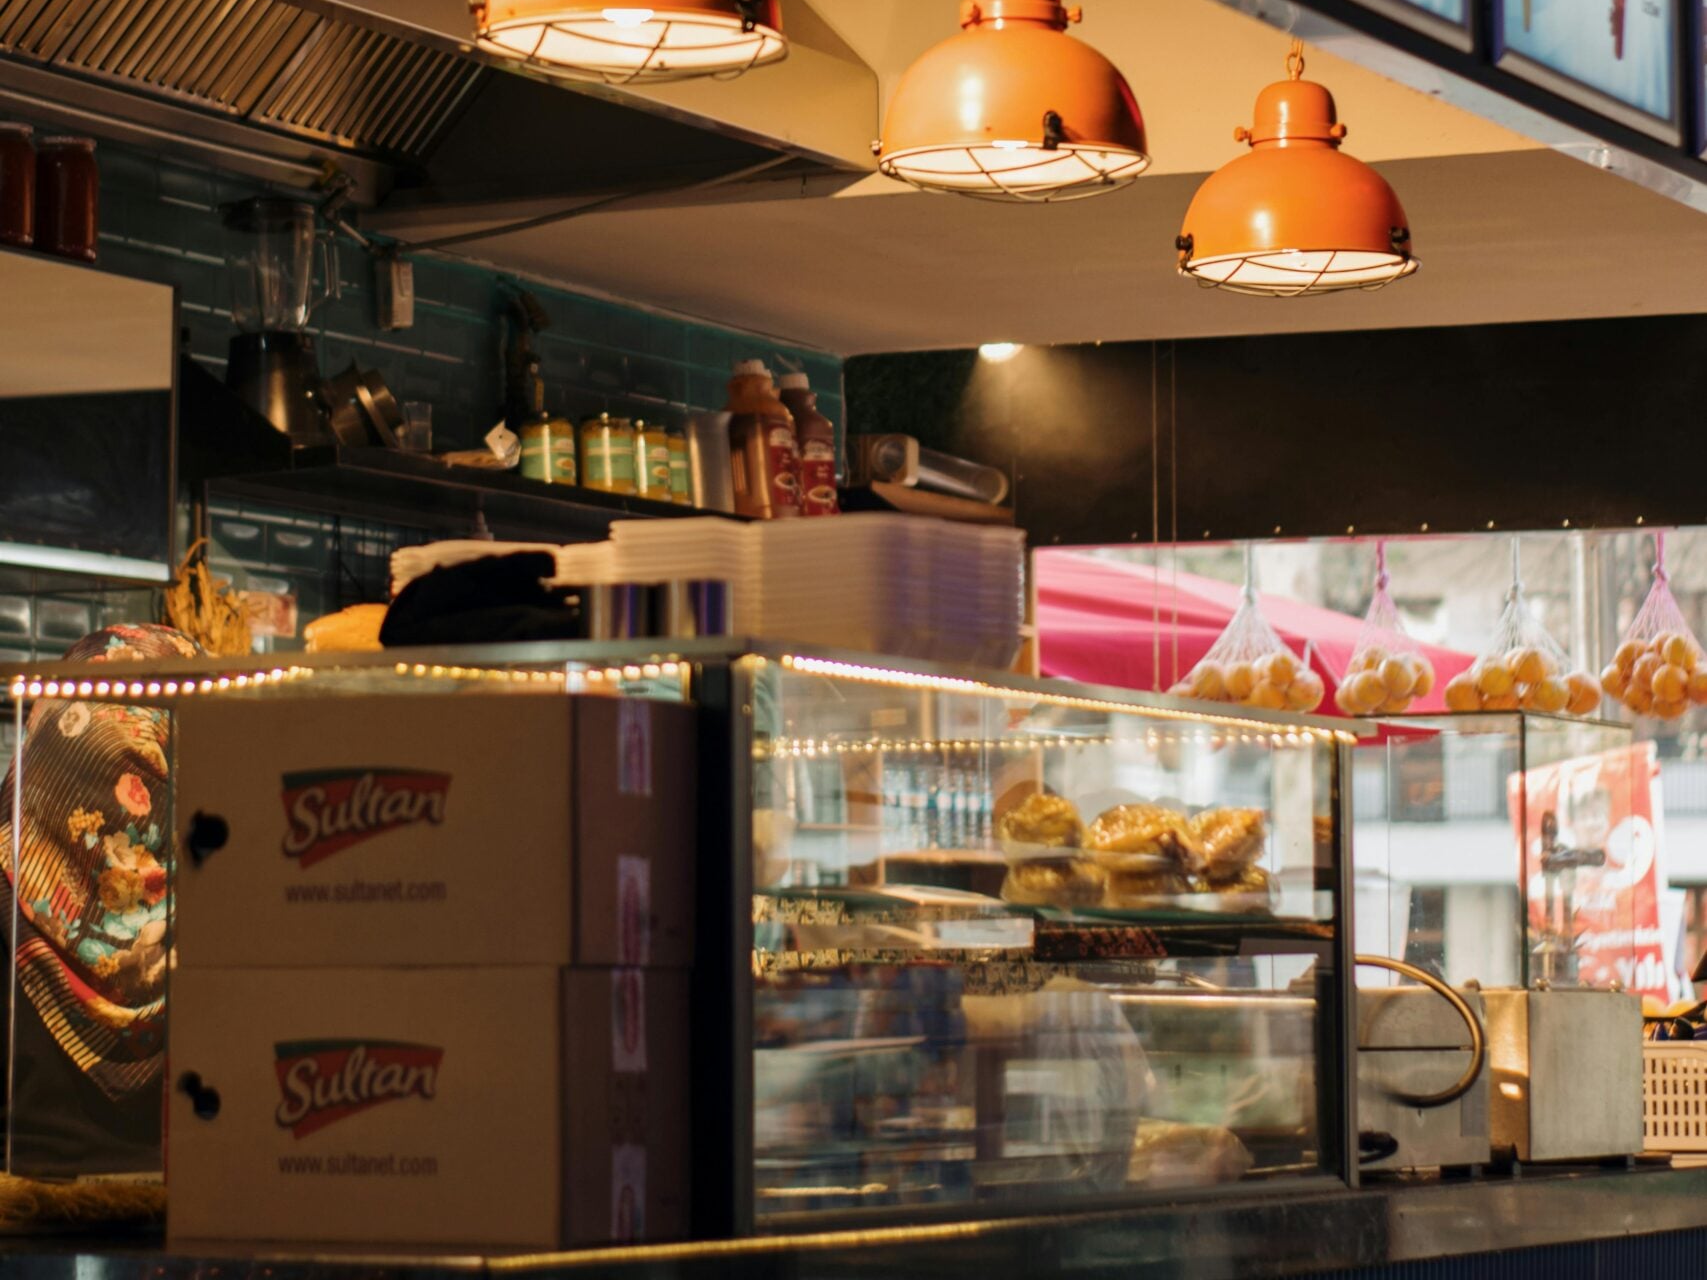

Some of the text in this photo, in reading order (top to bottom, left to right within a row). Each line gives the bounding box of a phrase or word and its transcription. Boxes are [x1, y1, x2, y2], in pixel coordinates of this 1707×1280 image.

[283, 772, 445, 858] Sultan
[286, 880, 447, 903] www.sultanet.com
[275, 1044, 436, 1131] Sultan
[278, 1153, 439, 1176] www.sultanet.com
